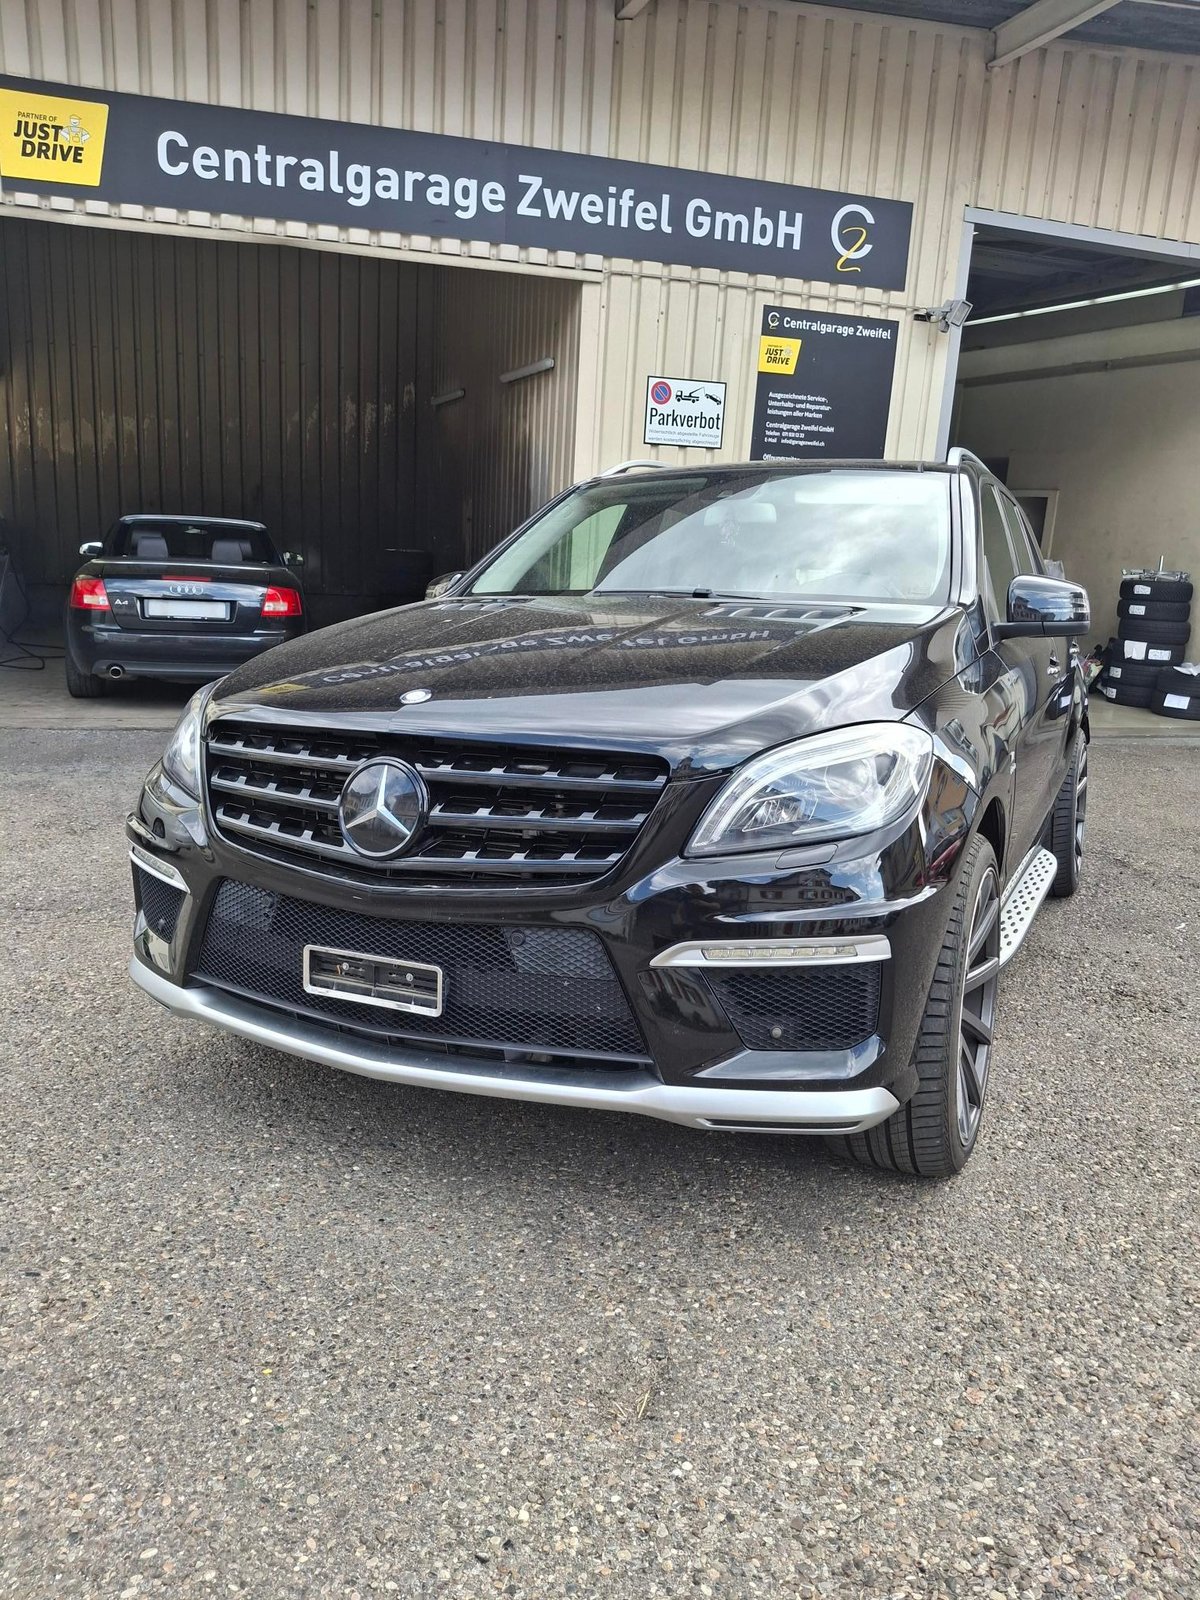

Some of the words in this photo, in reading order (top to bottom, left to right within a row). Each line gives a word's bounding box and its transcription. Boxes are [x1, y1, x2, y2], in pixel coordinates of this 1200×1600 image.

[17, 111, 47, 121] PARTNER
[13, 119, 64, 142] JUST
[21, 139, 84, 163] DRIVE
[156, 130, 506, 220] Centralgarage
[516, 174, 672, 233] Zweifel
[685, 198, 803, 251] GmbH
[783, 317, 854, 337] Centralgarage
[855, 325, 891, 340] Zweifel
[765, 348, 784, 356] JUST
[766, 356, 790, 365] DRIVE
[649, 407, 721, 430] Parkverbot
[767, 408, 792, 417] leistungen
[804, 411, 823, 419] Marken
[765, 421, 801, 431] Centralgarage
[801, 424, 819, 432] Zweifel
[819, 425, 835, 433] GmbH
[114, 598, 129, 606] A4
